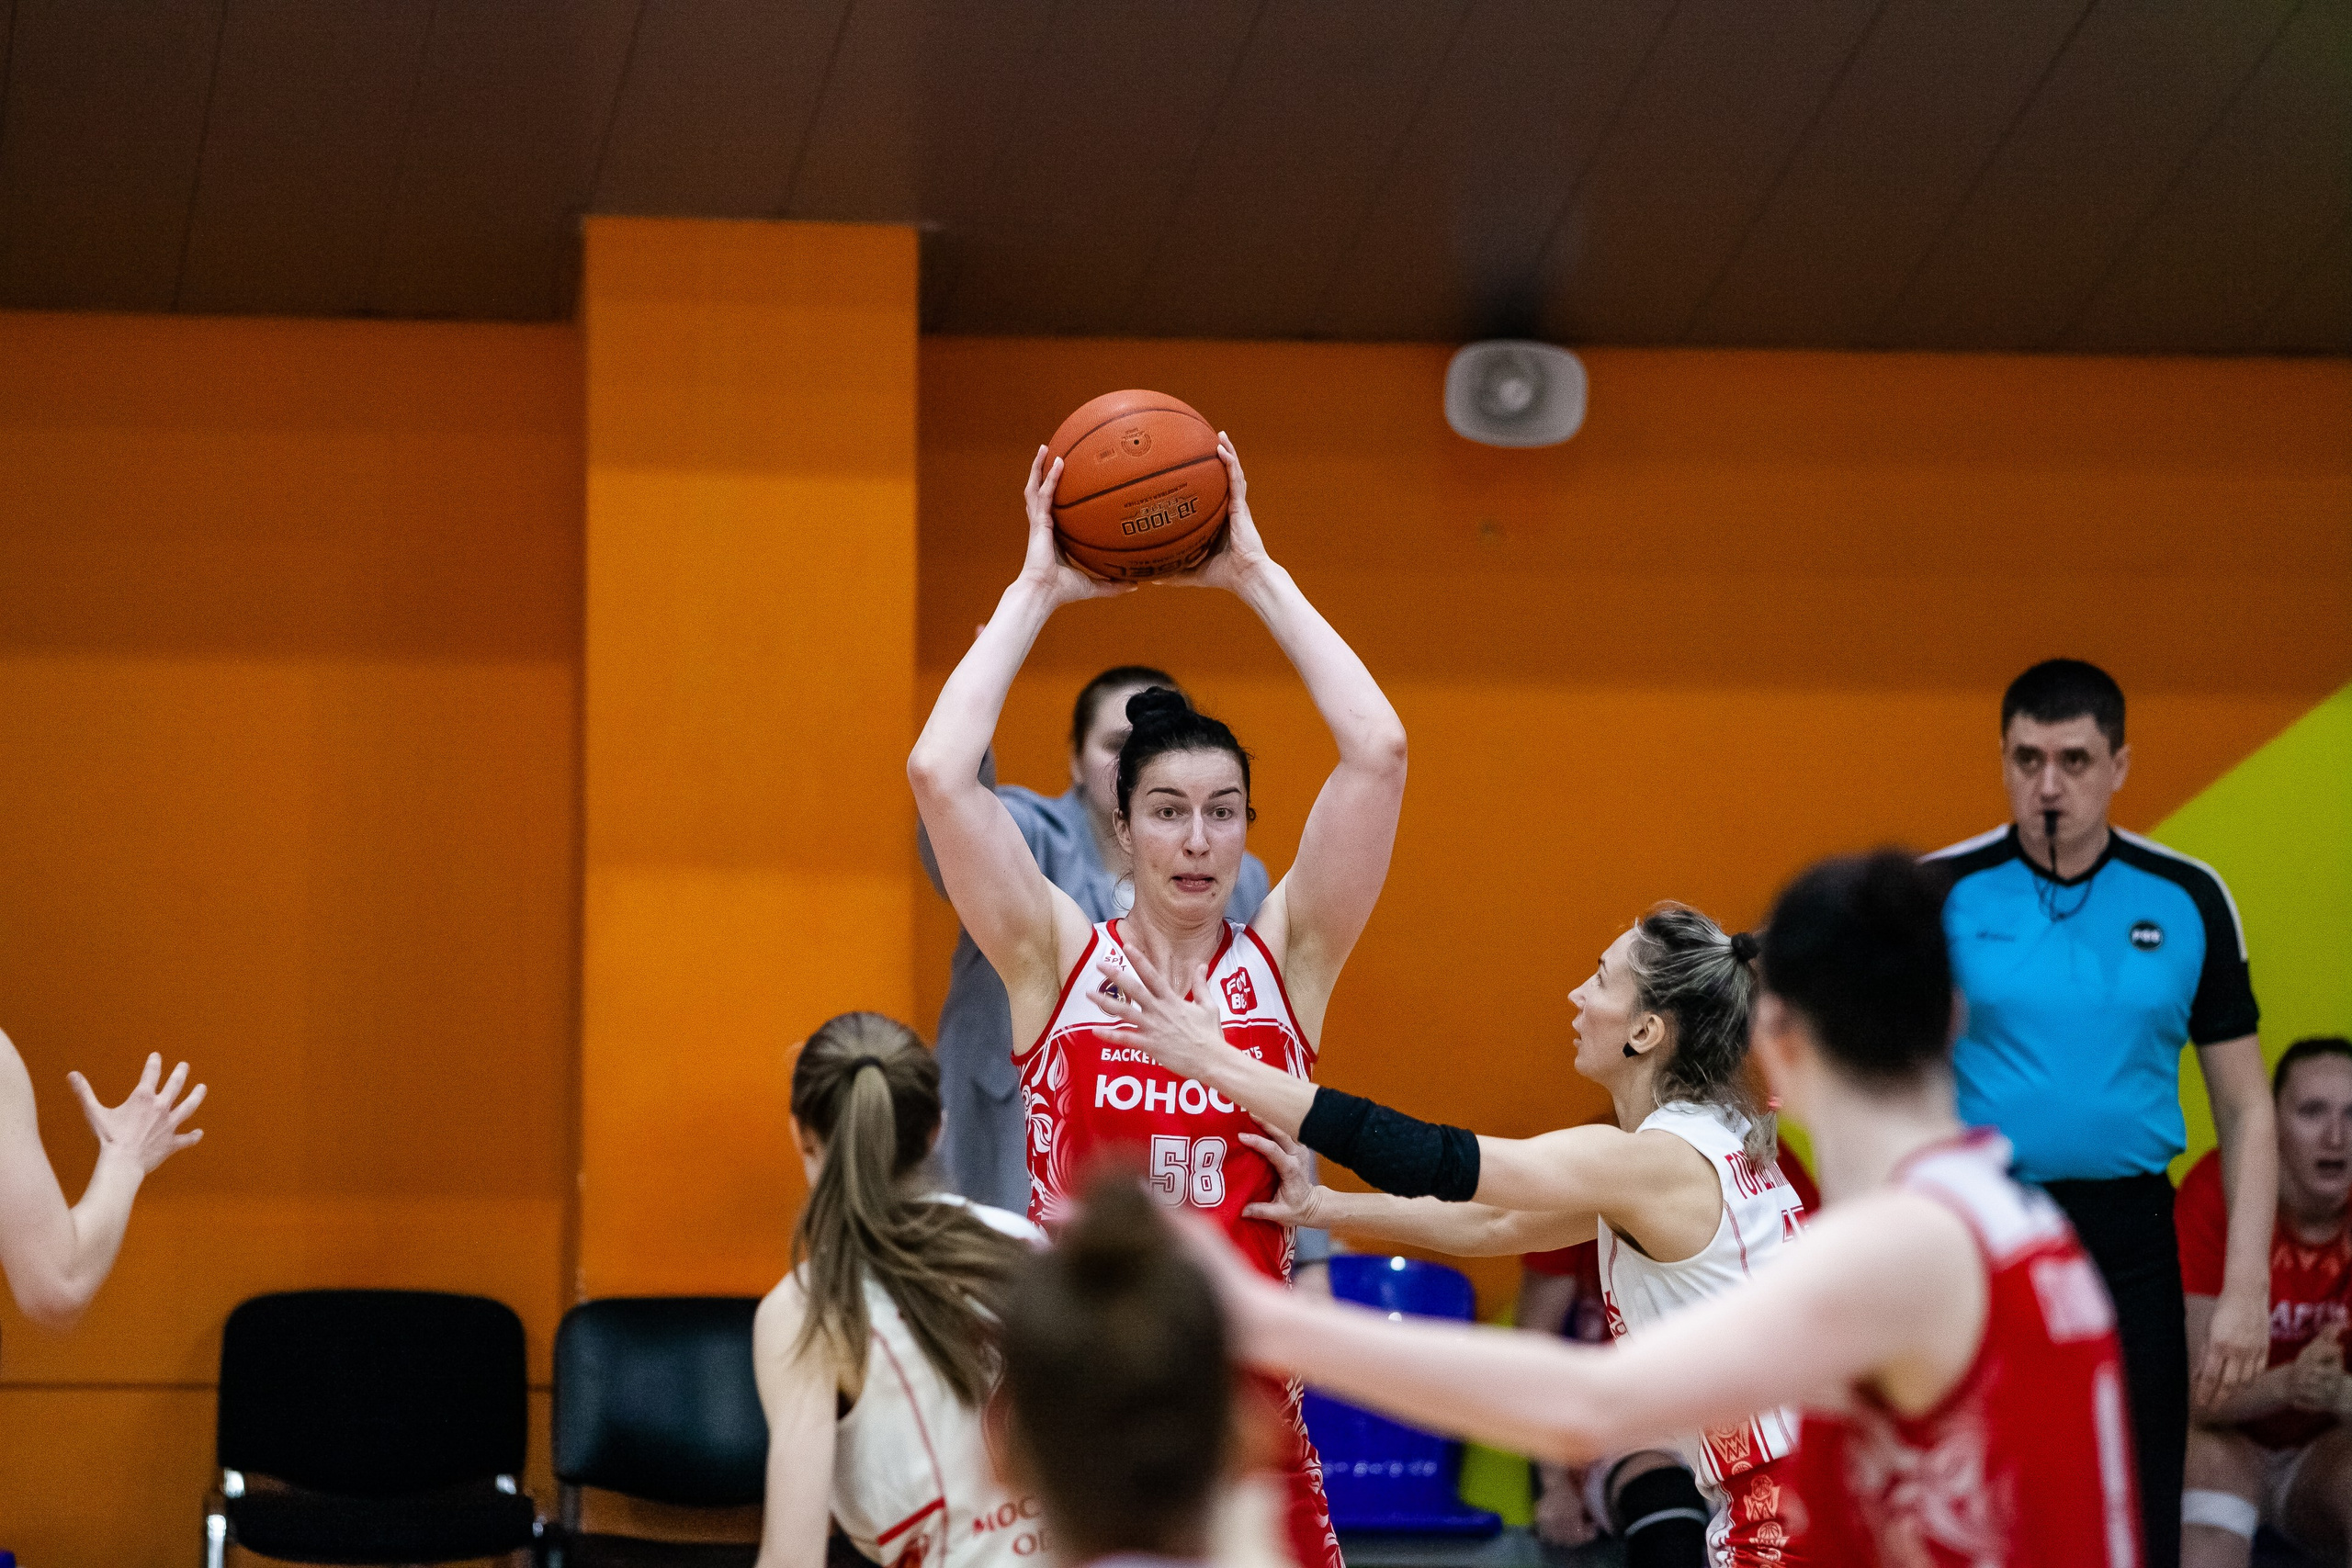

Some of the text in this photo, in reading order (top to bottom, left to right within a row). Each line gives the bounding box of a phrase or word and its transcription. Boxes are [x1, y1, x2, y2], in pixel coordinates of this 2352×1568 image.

[1120, 497, 1199, 536] JB-1000
[1094, 1075, 1248, 1115] ЮНОС
[1149, 1134, 1227, 1208] 58
